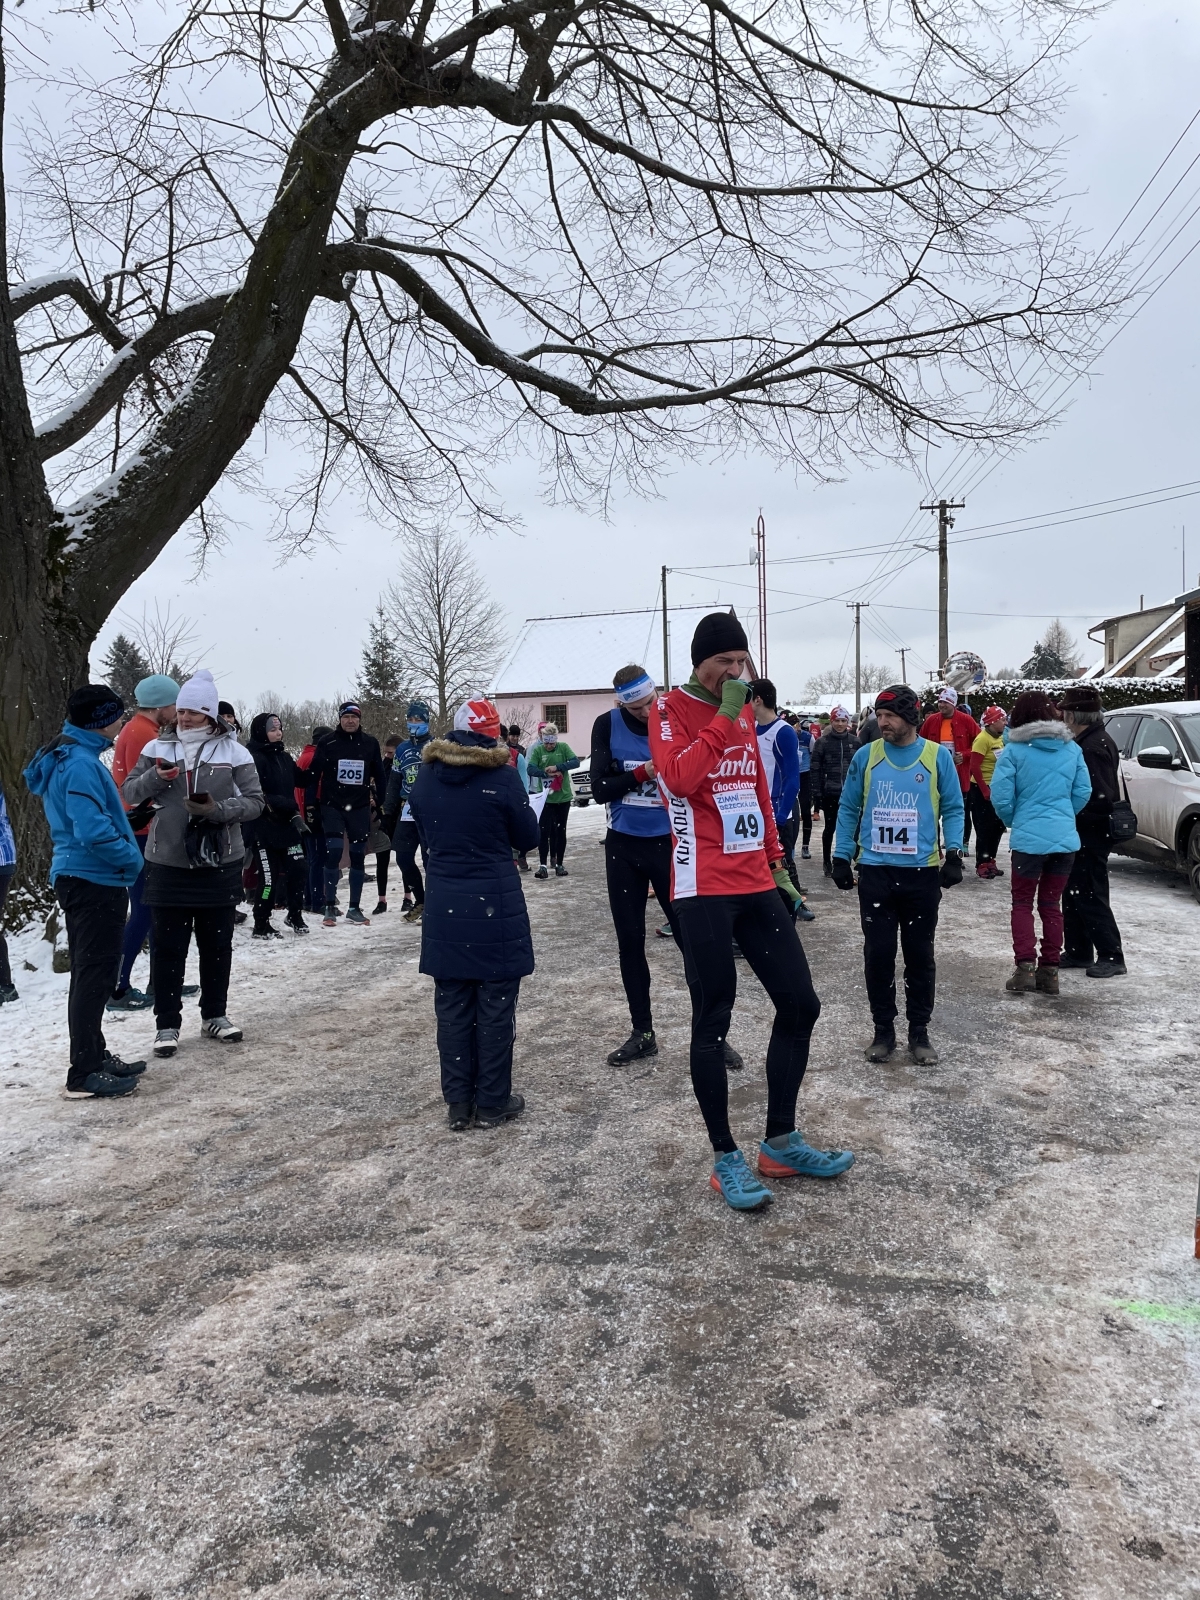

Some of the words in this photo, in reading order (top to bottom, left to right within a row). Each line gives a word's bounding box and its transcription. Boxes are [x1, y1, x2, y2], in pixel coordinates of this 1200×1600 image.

[339, 769, 362, 780] 205
[877, 781, 894, 790] THE
[876, 790, 919, 807] WIKOV
[734, 814, 759, 838] 49
[878, 826, 909, 845] 114
